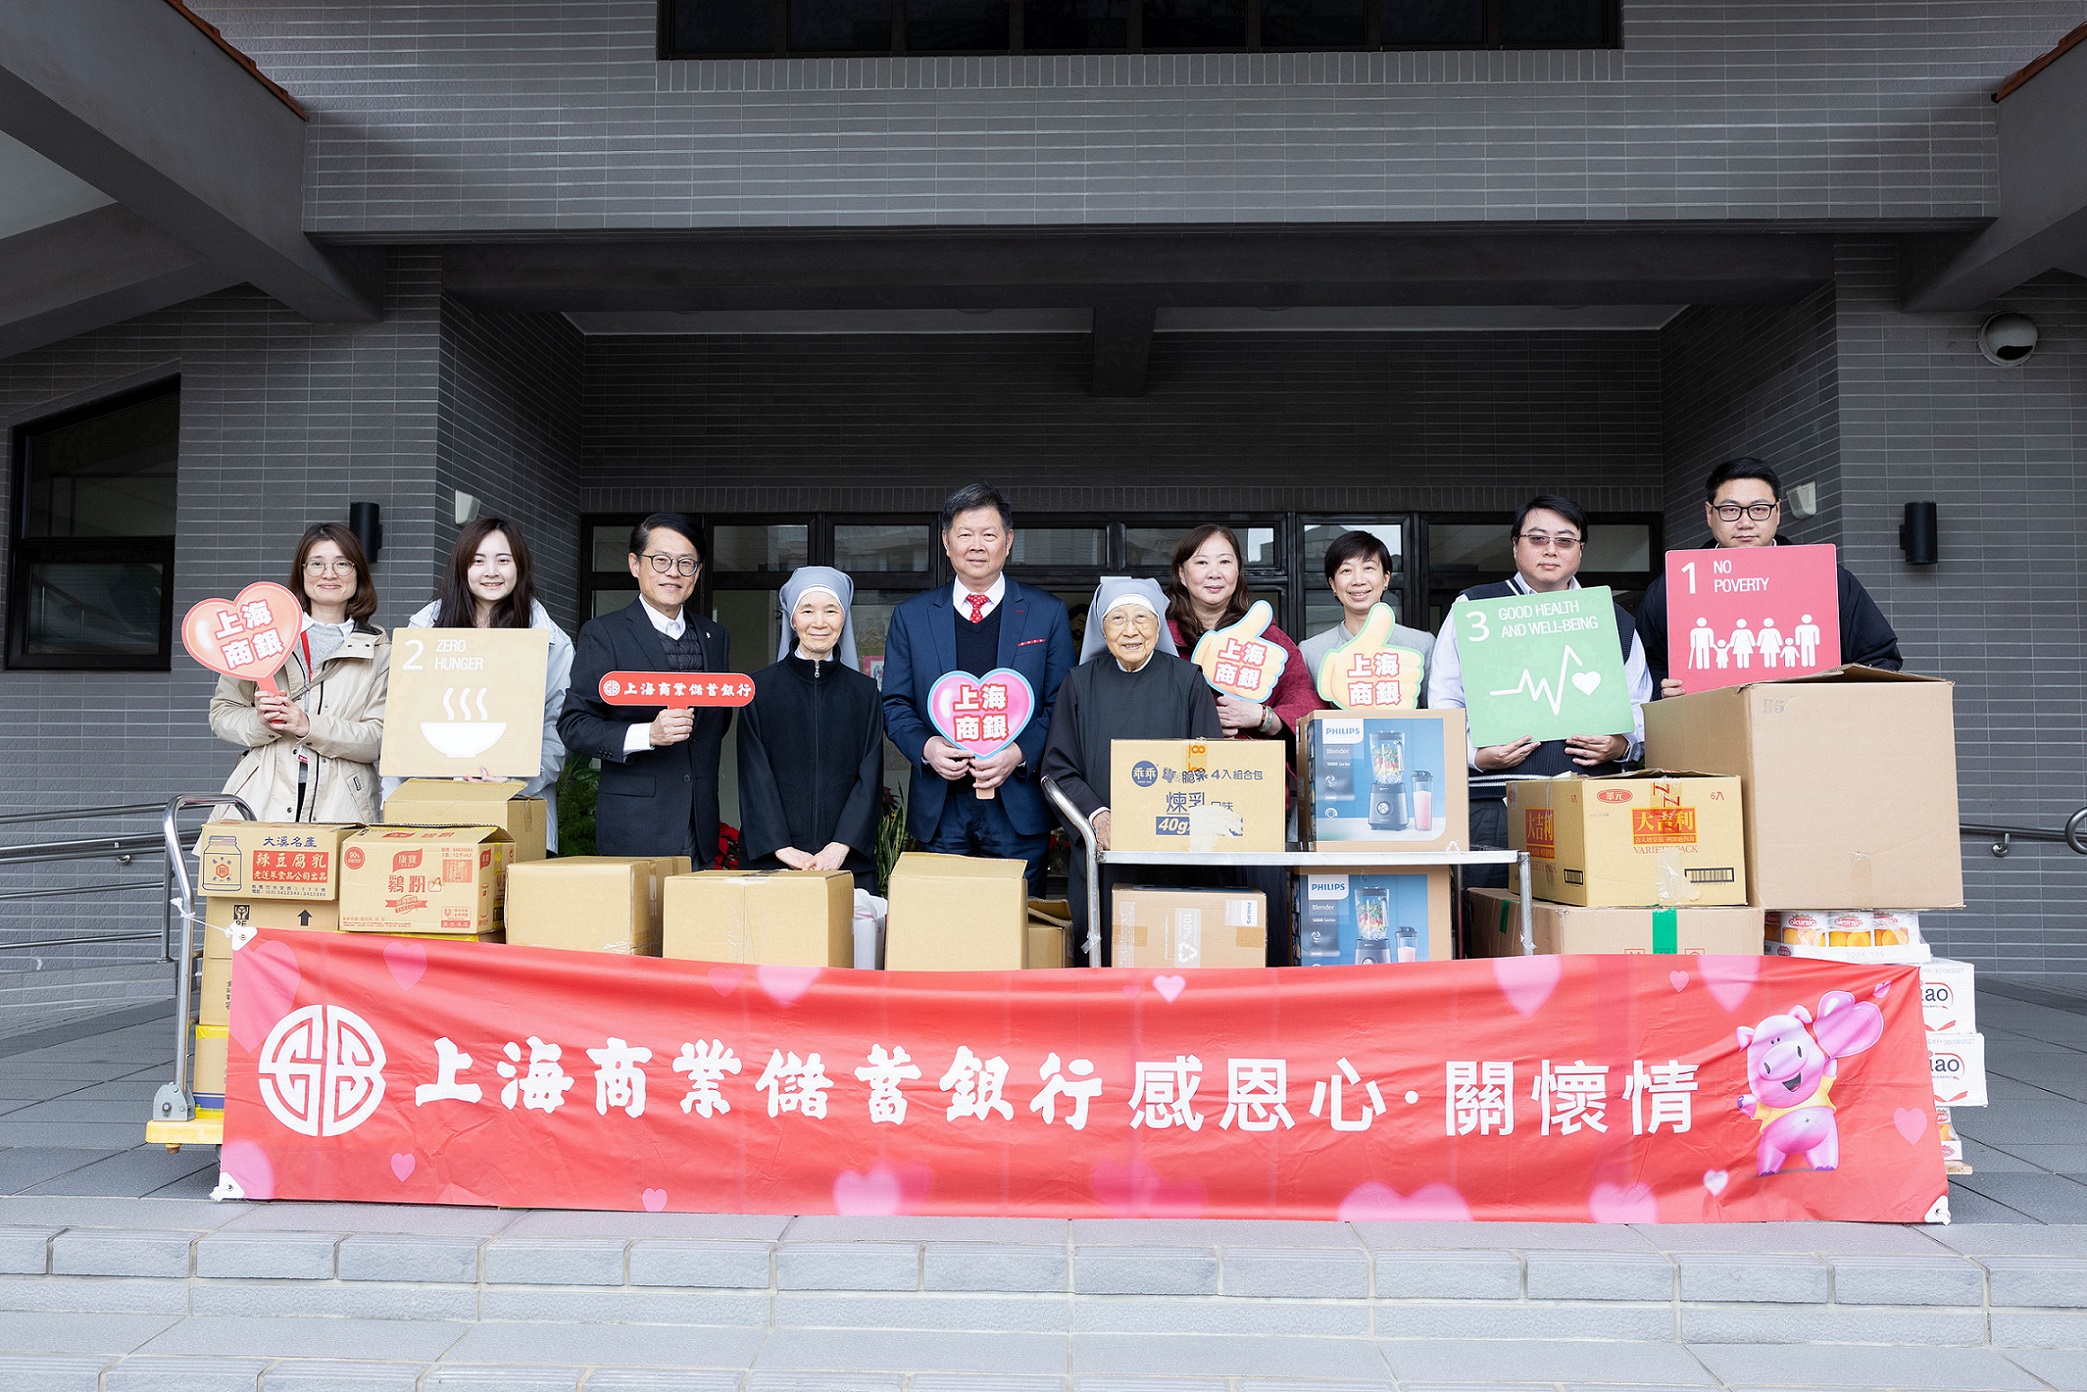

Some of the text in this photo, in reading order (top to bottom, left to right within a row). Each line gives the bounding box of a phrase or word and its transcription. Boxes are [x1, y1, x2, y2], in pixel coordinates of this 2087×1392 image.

[1680, 560, 1732, 594] 1 NO
[1714, 577, 1769, 593] POVERTY
[215, 599, 274, 640] 上海
[1465, 600, 1580, 642] 3 GOOD HEALTH
[1501, 616, 1599, 639] AND WELL-BEING
[220, 627, 285, 670] 商銀
[402, 639, 466, 670] 2 ZERO
[1218, 638, 1268, 666] 上海
[434, 657, 484, 670] HUNGER
[1213, 662, 1262, 691] 商銀
[1347, 652, 1400, 678] 上海
[623, 681, 752, 697] 上海商業儲蓄銀行
[953, 683, 1008, 711] 上海
[1348, 680, 1401, 707] 商銀
[954, 713, 1009, 742] 商銀
[1133, 767, 1156, 780] 乖乖
[1605, 792, 1624, 801] 華元
[1710, 791, 1725, 801] 6入
[1527, 812, 1553, 841] 大吉利
[1635, 811, 1693, 832] 大吉利
[263, 836, 317, 848] 大溪名產
[256, 853, 327, 869] 辣豆腐乳
